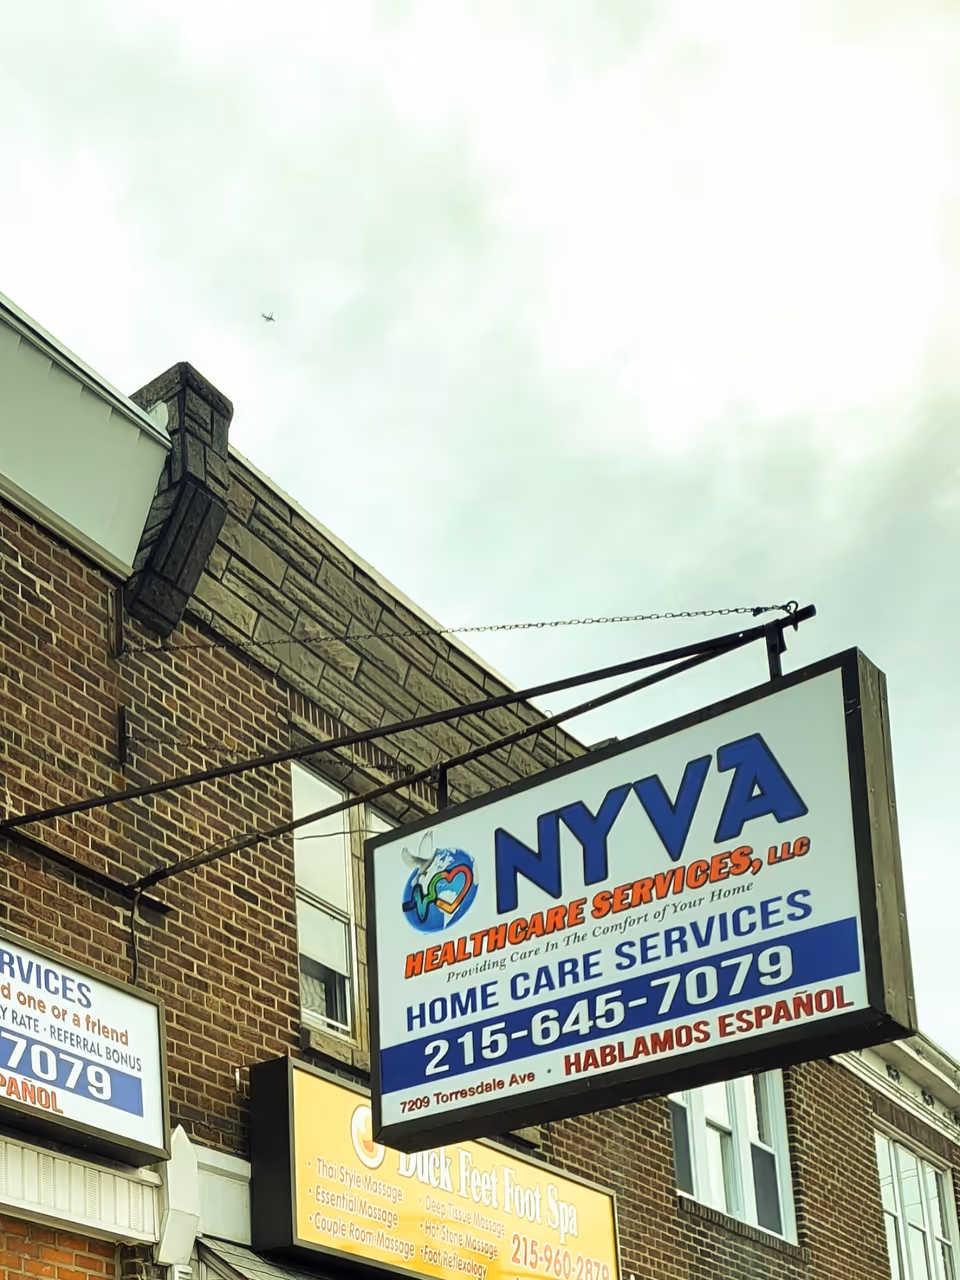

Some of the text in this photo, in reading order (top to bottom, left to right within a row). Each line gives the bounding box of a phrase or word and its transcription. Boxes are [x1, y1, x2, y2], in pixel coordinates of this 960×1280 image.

[494, 732, 809, 915] NYVA
[404, 836, 811, 979] HEALTHCARE SERVICES, LLC
[446, 882, 754, 983] Providing Care In The Comfort of Your Home
[406, 889, 813, 1032] HOME CARE SERVICES
[17, 991, 46, 1014] one
[52, 1005, 68, 1021] or
[72, 1012, 80, 1027] a
[85, 1014, 129, 1047] friend
[424, 944, 794, 1077] 215-645-7079
[12, 1011, 39, 1033] RATE
[50, 1025, 103, 1058] REFERRAL
[106, 1046, 142, 1072] BONUS
[400, 985, 854, 1114] 7209 Torresdale Ave HABLAMOS ESPAÑOL
[315, 1185, 398, 1229] Essential Massage
[317, 1158, 403, 1204] Thai Style Massage
[457, 1147, 499, 1210] Feet
[502, 1165, 543, 1225] Foot
[546, 1183, 579, 1245] Spa
[314, 1212, 415, 1260] Couple Room Massage
[425, 1195, 506, 1239] Deep Tissue Massage
[425, 1220, 498, 1260] Hot Stone Massage
[423, 1244, 441, 1265] Foot
